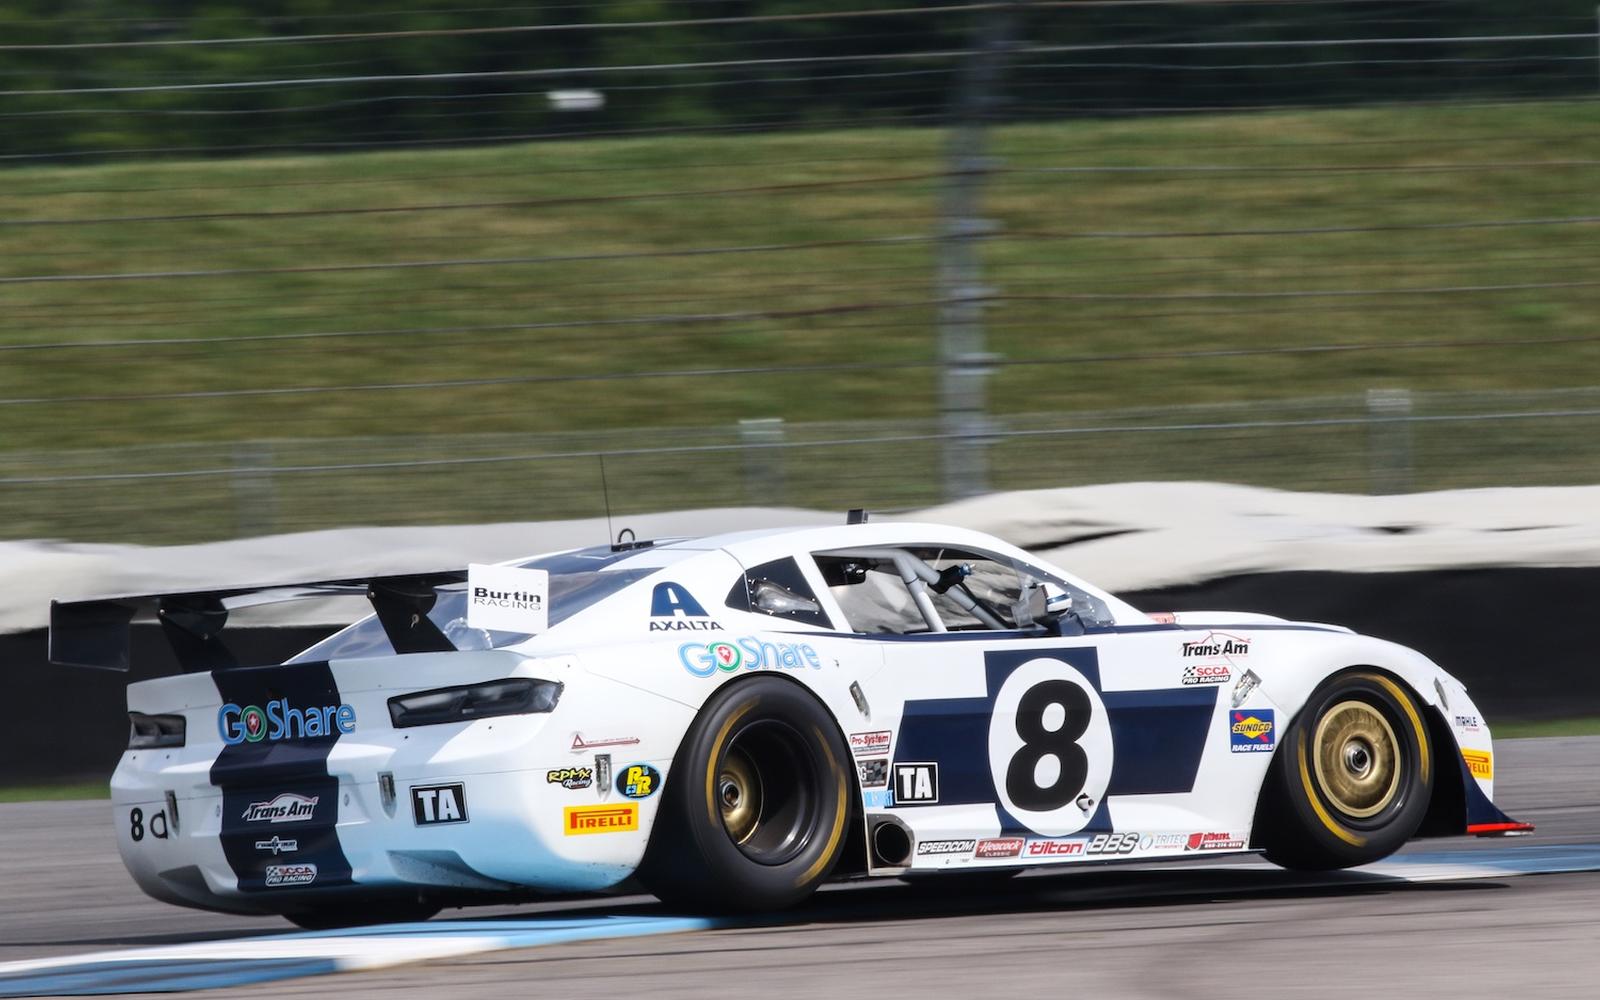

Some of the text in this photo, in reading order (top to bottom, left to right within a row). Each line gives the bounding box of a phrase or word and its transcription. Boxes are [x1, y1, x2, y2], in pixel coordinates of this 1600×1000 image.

[474, 587, 541, 603] Burtin
[474, 597, 541, 611] RACING
[650, 620, 725, 632] AXALTA
[1183, 640, 1249, 656] Trans Am
[1196, 666, 1229, 676] SCCA
[1199, 675, 1230, 683] RACING
[1233, 722, 1272, 733] SUNOCO
[851, 734, 889, 746] Pro-System
[1006, 679, 1092, 812] 8
[1232, 743, 1274, 752] RACE FUELS
[547, 768, 592, 783] RPMX
[899, 767, 933, 799] TA
[248, 801, 314, 819] Trans Am
[417, 789, 461, 821] TA
[570, 808, 632, 829] PIRELLI
[1087, 832, 1139, 855] BBS
[1155, 834, 1187, 844] TRITEC
[918, 841, 975, 853] SPEEDCOM
[1029, 841, 1083, 855] tilton
[278, 866, 313, 875] SCCA
[283, 874, 313, 882] RACING
